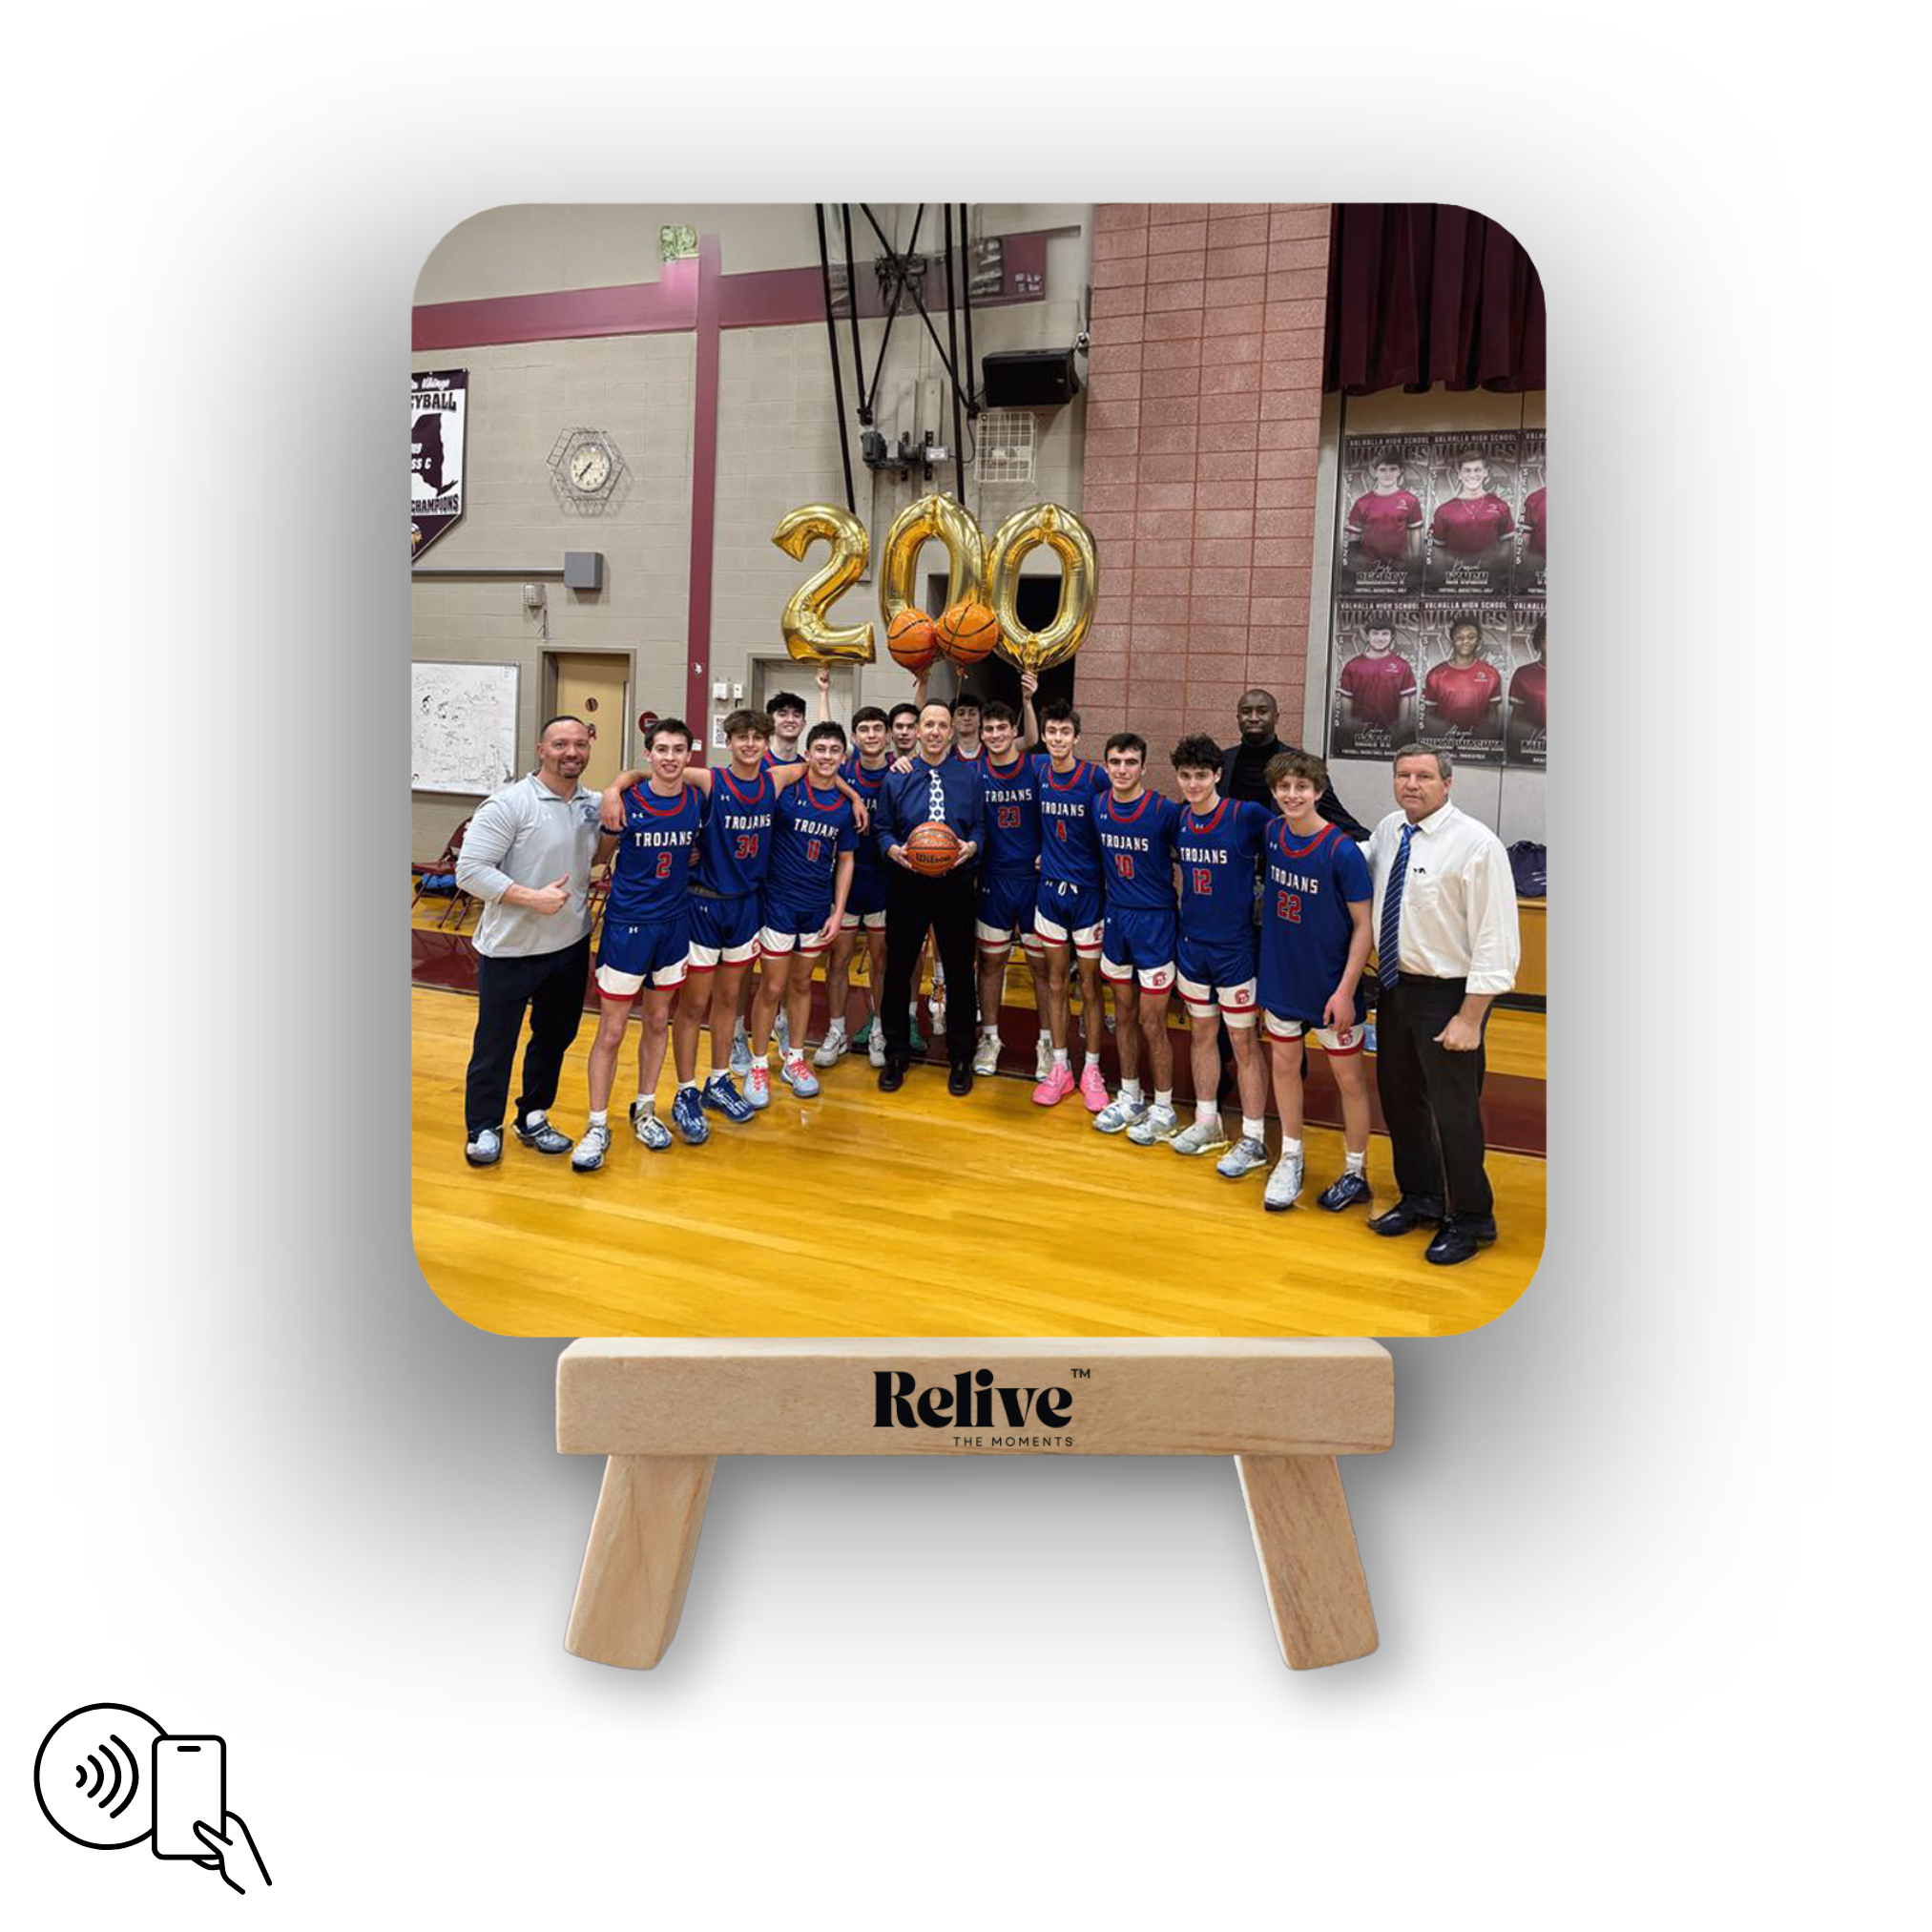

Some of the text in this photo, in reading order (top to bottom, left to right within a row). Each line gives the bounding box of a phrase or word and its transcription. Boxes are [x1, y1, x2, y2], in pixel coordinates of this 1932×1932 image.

[1490, 432, 1517, 441] SCHOOL
[1340, 602, 1374, 611] VALHALLA
[1394, 602, 1420, 611] SCHOOL
[1424, 601, 1507, 610] VALHALLA HIGH SCHOOL
[985, 788, 1032, 802] TROJANS
[1041, 800, 1085, 817] TROJANS
[725, 814, 772, 830] TROJANS
[634, 831, 694, 847] TROJANS
[735, 833, 759, 860] 34
[1100, 833, 1150, 852] TROJANS
[807, 839, 821, 862] 11
[1180, 846, 1228, 864] TROJANS
[656, 851, 673, 879] 2
[1114, 853, 1134, 880] 10
[1193, 867, 1213, 896] 12
[1271, 864, 1319, 894] TROJANS
[1277, 890, 1301, 924] 22
[873, 1368, 1091, 1429] Relive TM
[953, 1436, 1073, 1447] THE MOMENTS
